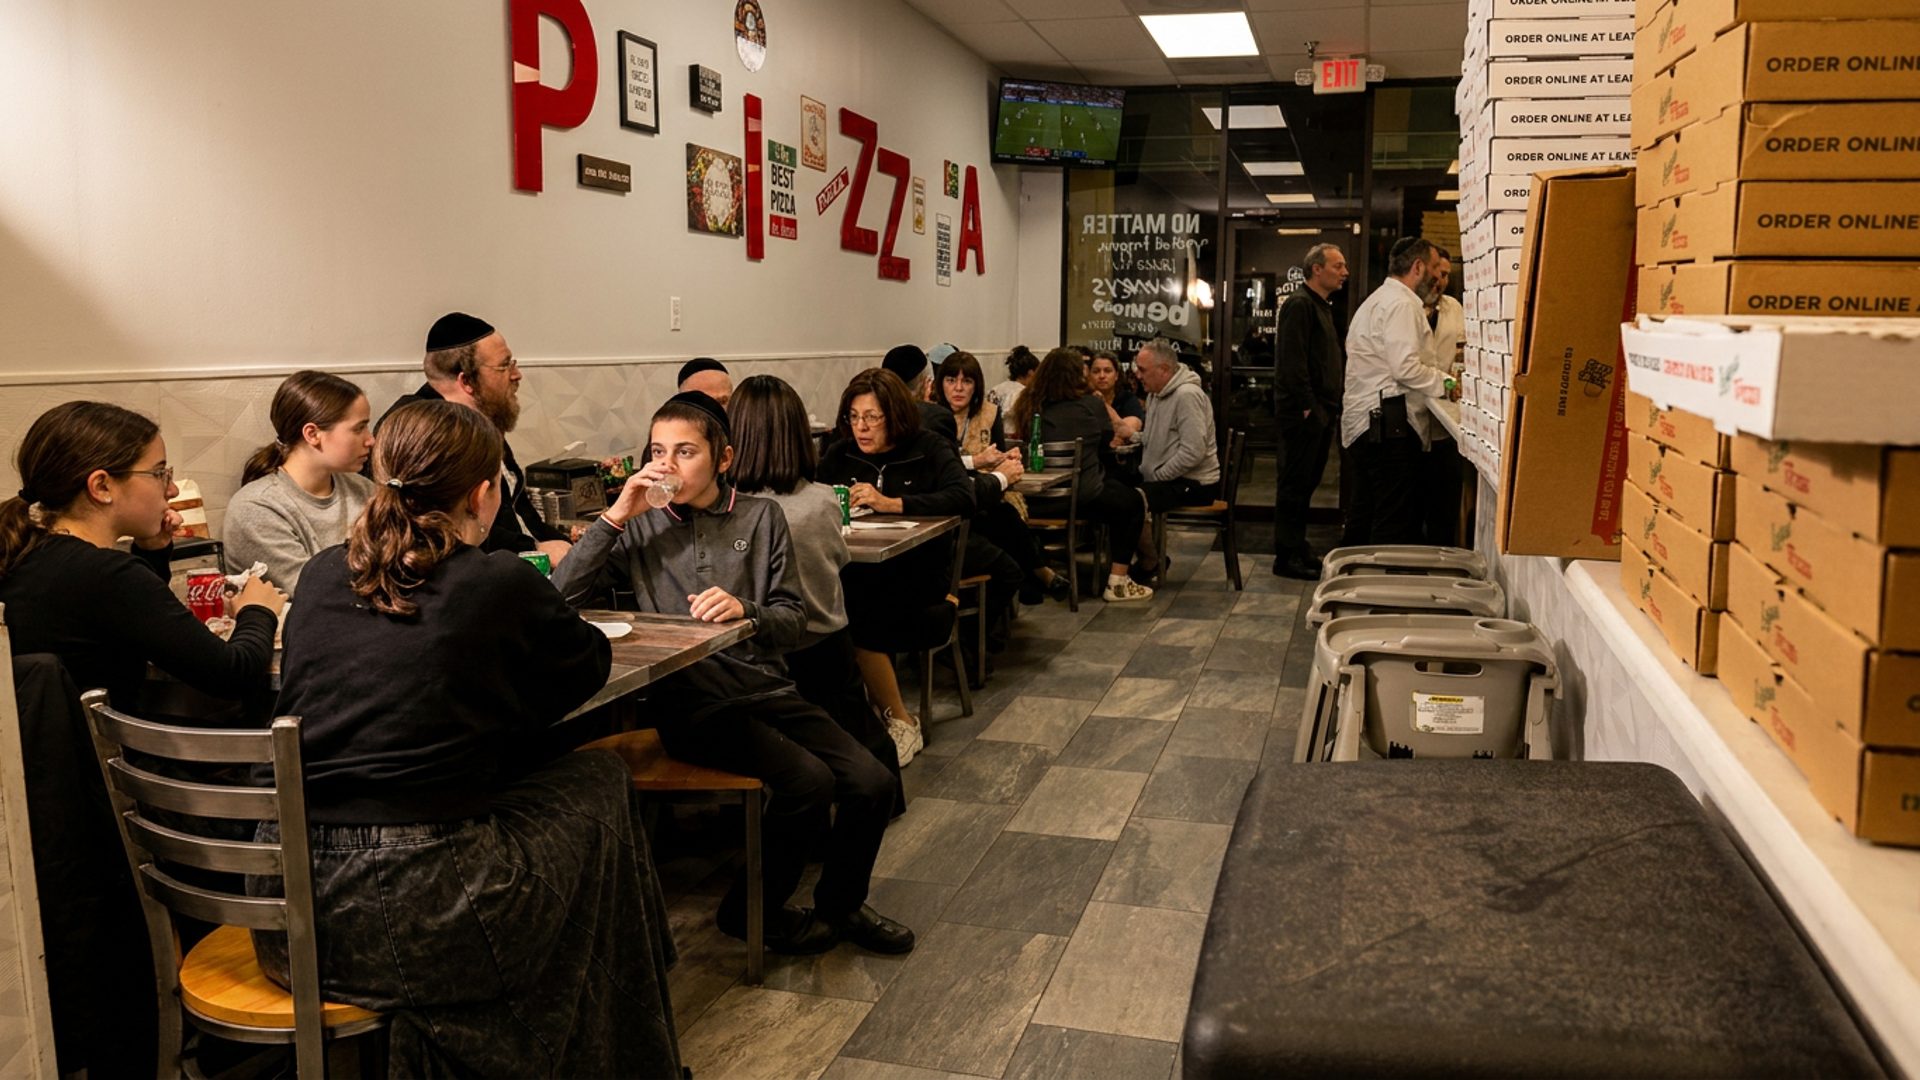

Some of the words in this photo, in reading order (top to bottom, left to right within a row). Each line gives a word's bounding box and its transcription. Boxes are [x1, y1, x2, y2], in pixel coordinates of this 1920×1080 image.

[1505, 34, 1543, 43] ORDER
[1546, 33, 1588, 42] ONLINE
[1591, 33, 1606, 41] AT
[1766, 56, 1840, 72] ORDER
[1322, 60, 1359, 89] EXIT
[1505, 76, 1542, 85] ORDER
[1545, 75, 1587, 84] ONLINE
[1590, 75, 1605, 83] AT
[1511, 114, 1548, 123] ORDER
[1551, 114, 1592, 122] ONLINE
[1595, 113, 1610, 122] AT
[1766, 137, 1840, 152] ORDER
[1507, 152, 1544, 161] ORDER
[1547, 152, 1588, 161] ONLINE
[1591, 152, 1606, 160] AT
[771, 163, 795, 190] BEST
[771, 189, 796, 215] PIZZA
[1757, 214, 1831, 229] ORDER
[1838, 214, 1920, 230] ONLINE
[1748, 295, 1821, 310] ORDER
[1828, 296, 1911, 312] ONLINE
